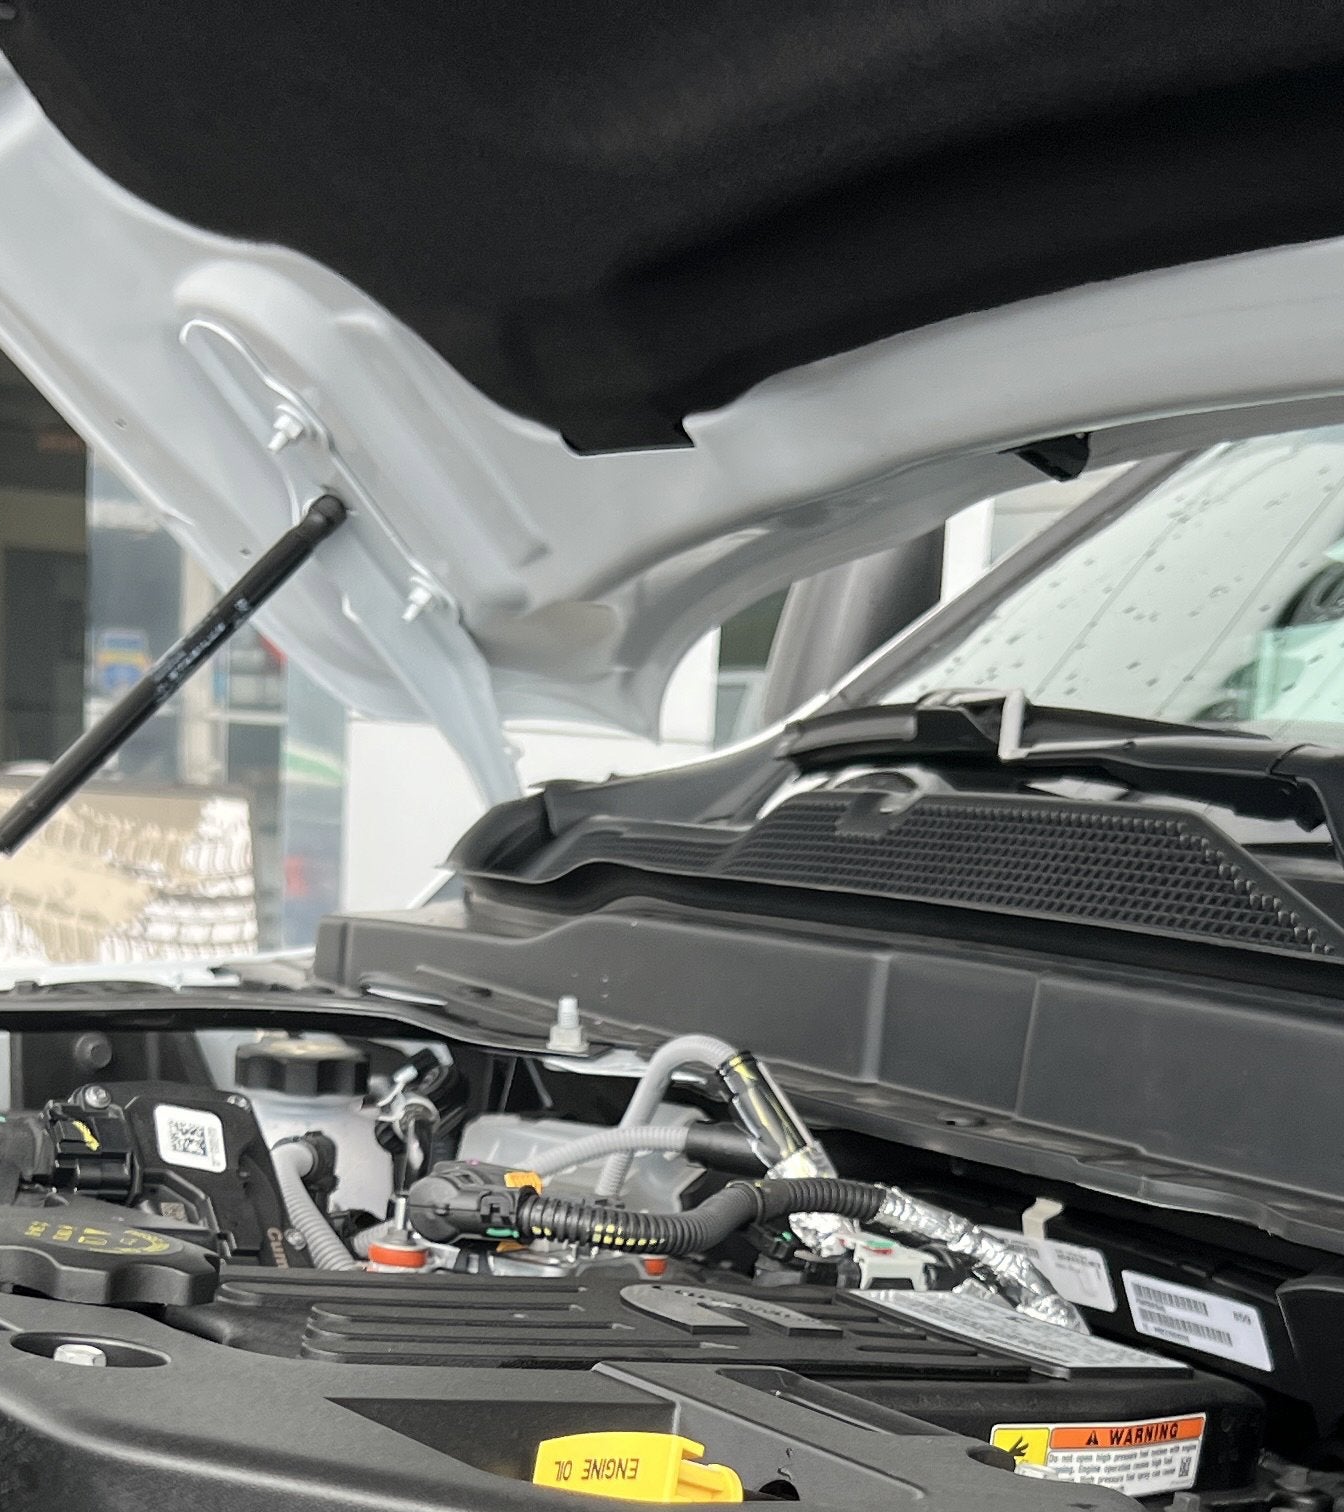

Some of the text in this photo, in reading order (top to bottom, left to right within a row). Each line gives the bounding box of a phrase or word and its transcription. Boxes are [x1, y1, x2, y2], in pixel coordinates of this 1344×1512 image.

[1110, 1423, 1179, 1444] WARNING
[555, 1458, 640, 1481] ENGINE OIL
